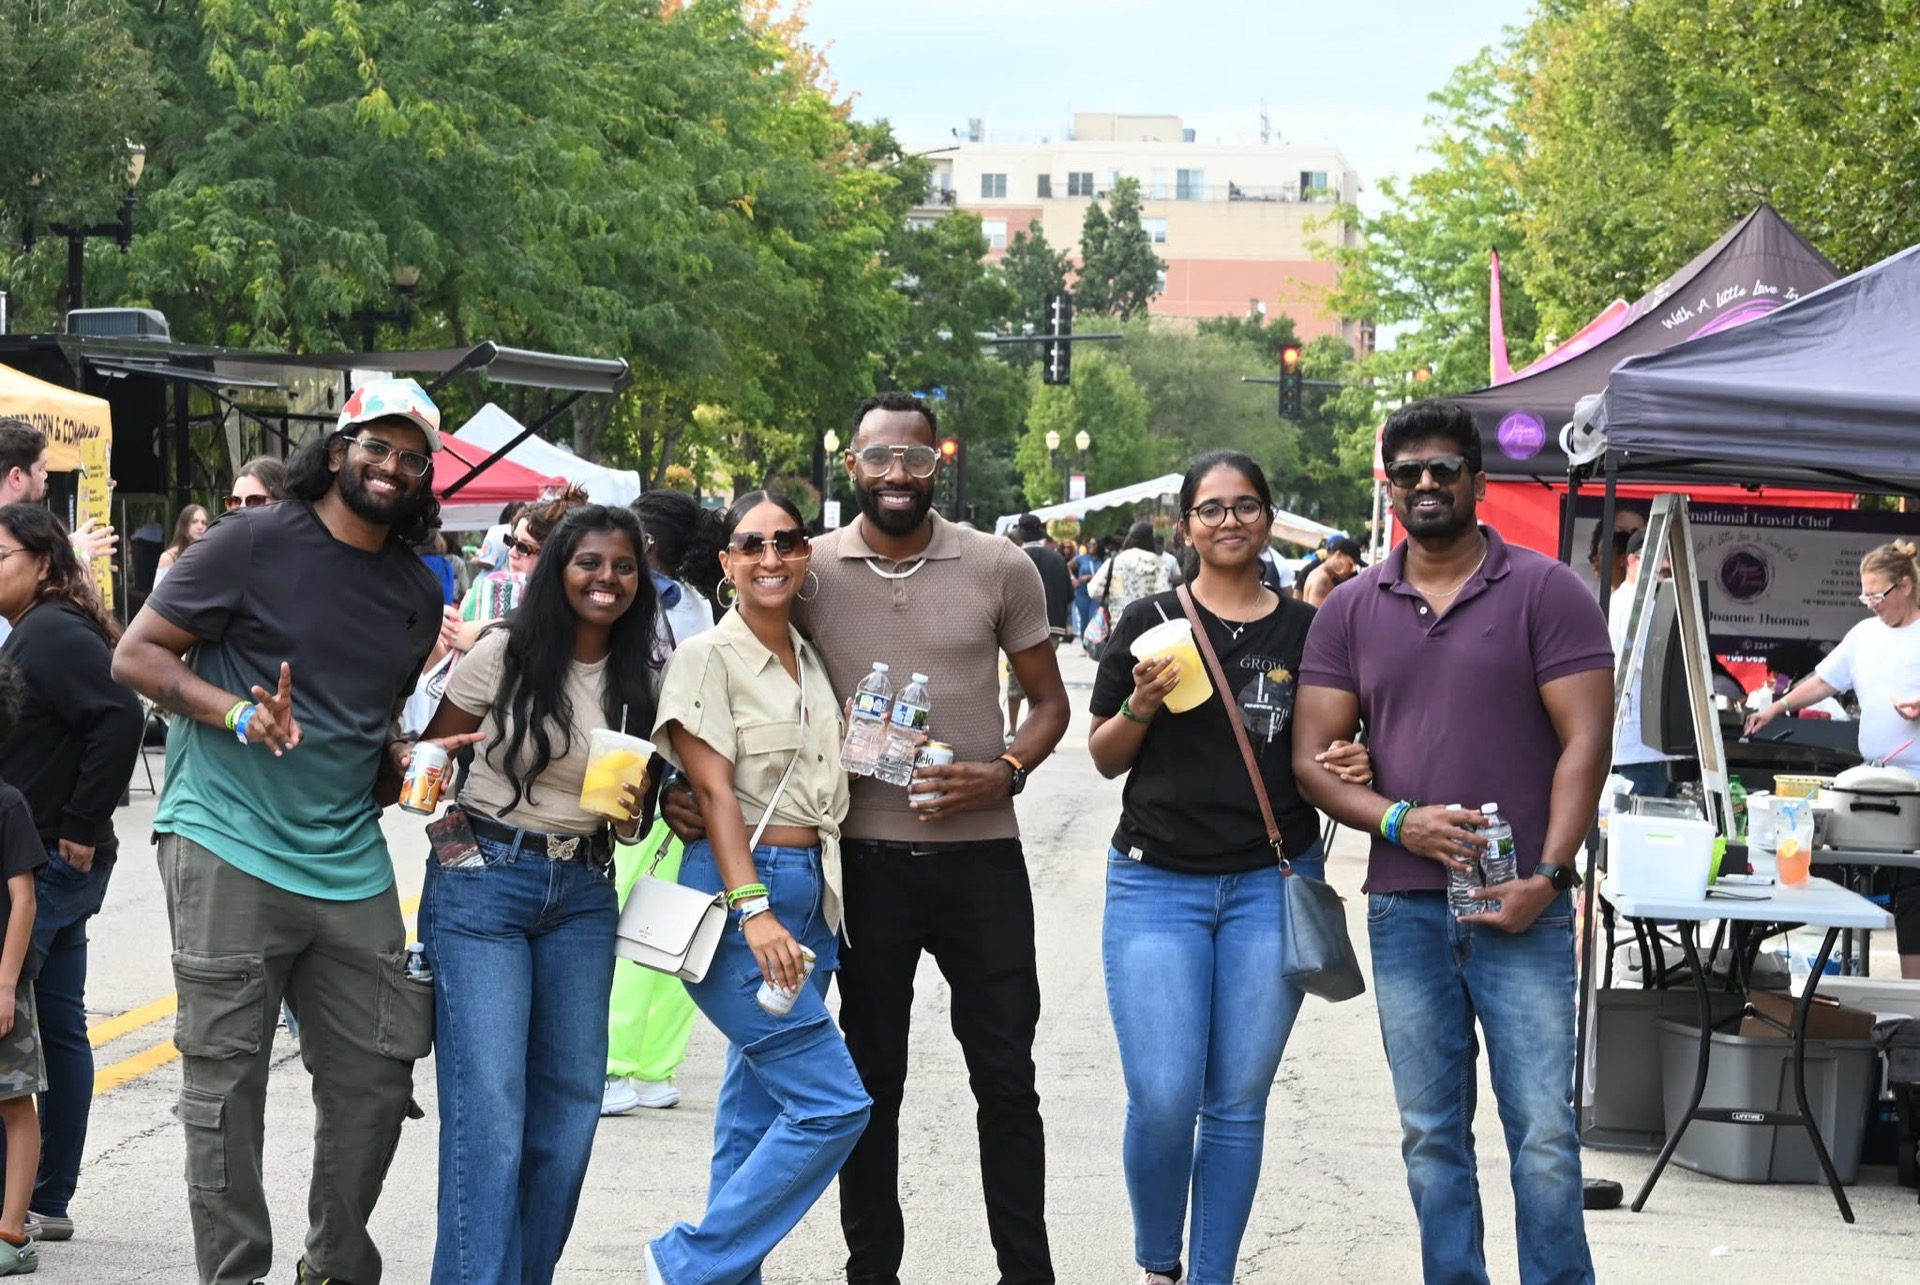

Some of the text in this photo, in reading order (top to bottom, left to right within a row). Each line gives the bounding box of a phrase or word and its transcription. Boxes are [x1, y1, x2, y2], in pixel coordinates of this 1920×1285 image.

[1662, 306, 1695, 329] With
[1697, 298, 1711, 314] A
[1717, 285, 1747, 308] Little
[1753, 279, 1778, 296] Love
[55, 415, 61, 441] &
[1689, 510, 1832, 528] national Travel Chef
[1760, 612, 1810, 627] Thomas
[1239, 657, 1286, 671] GROW
